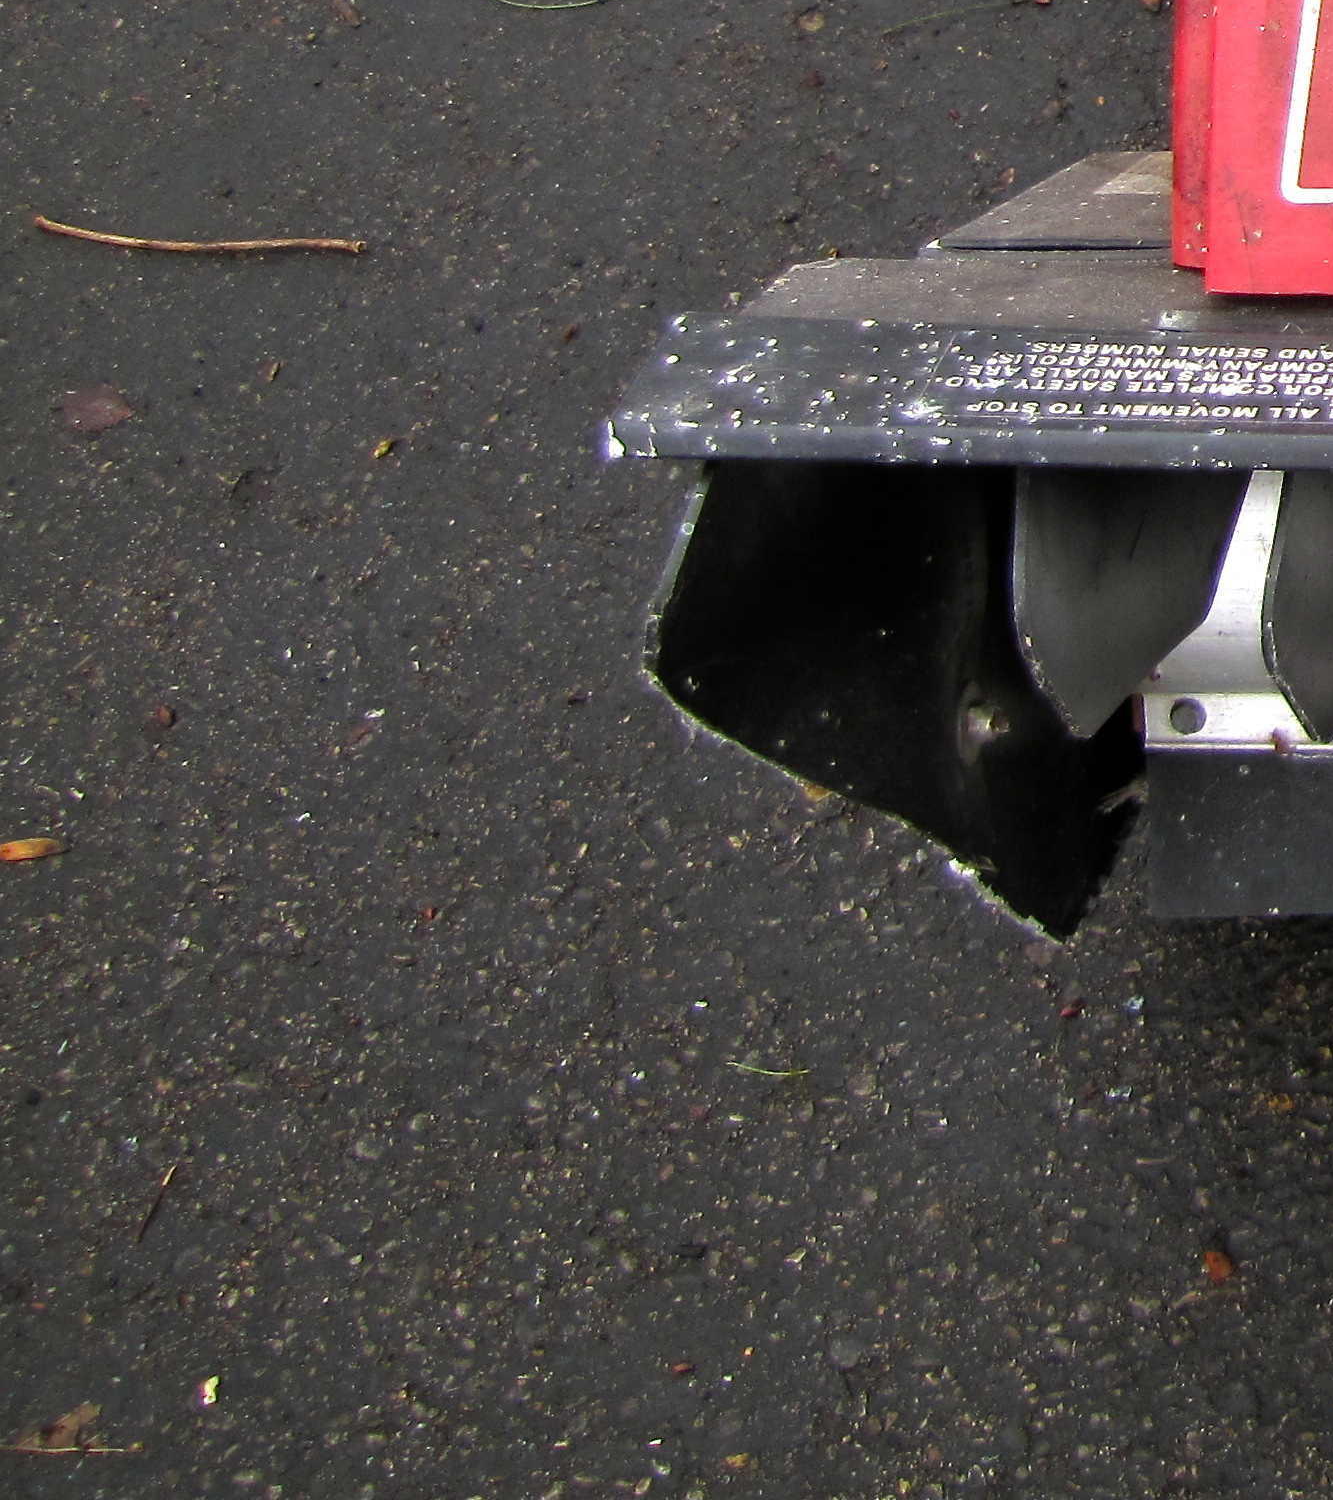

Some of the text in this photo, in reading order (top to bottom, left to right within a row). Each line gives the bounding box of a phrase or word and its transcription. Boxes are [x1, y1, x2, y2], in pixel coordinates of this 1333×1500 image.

[1025, 341, 1165, 356] NUMBERS.
[1176, 346, 1269, 359] SERIAL
[1031, 365, 1169, 380] MANUALS
[1016, 377, 1116, 392] SAFETY
[1128, 379, 1278, 396] COMPLETE
[966, 400, 1039, 414] STOP
[1048, 402, 1084, 415] TO
[1094, 403, 1259, 418] MOVEMENT
[1268, 407, 1319, 419] ALL
